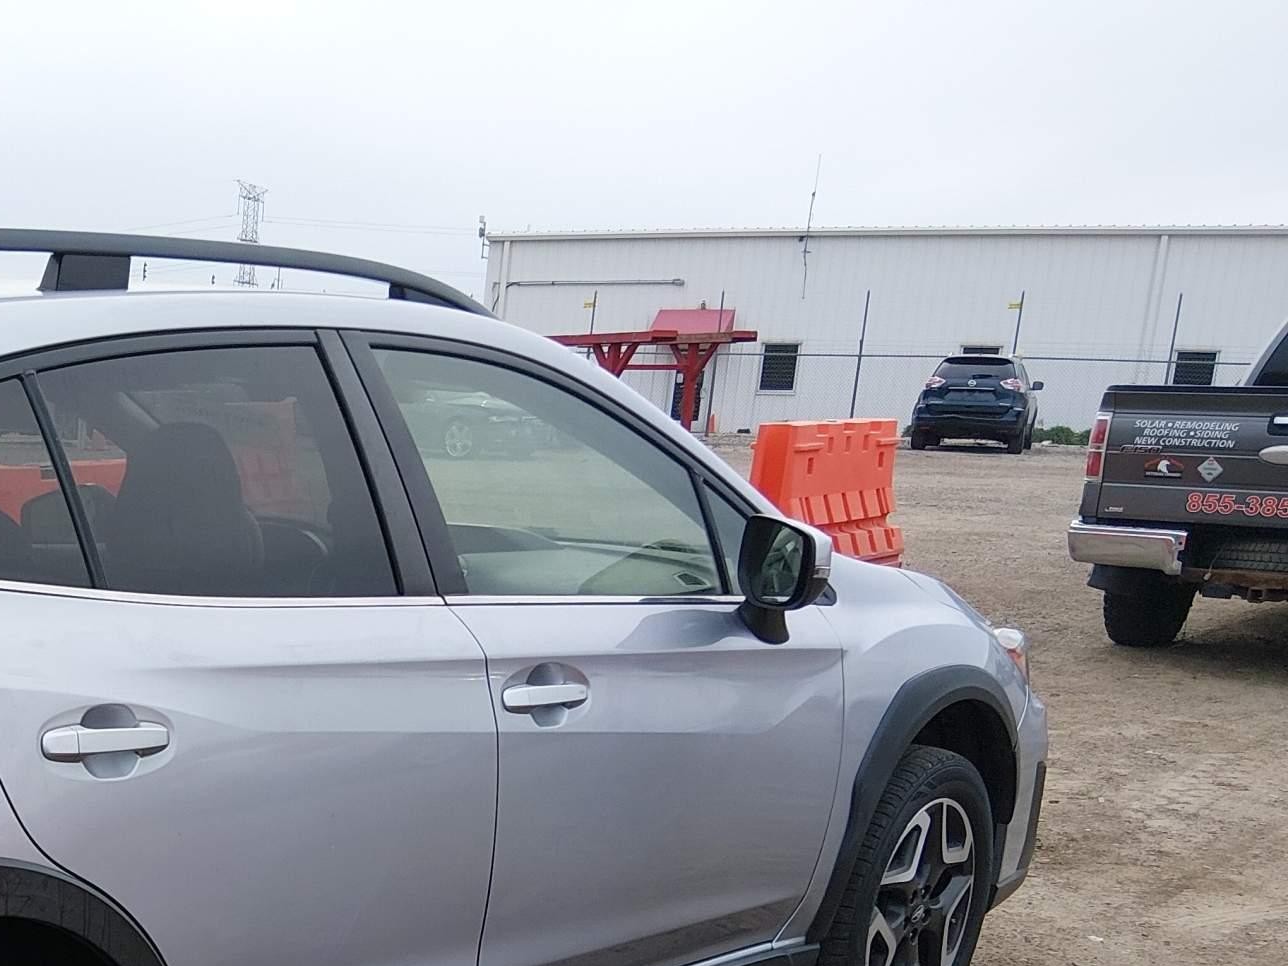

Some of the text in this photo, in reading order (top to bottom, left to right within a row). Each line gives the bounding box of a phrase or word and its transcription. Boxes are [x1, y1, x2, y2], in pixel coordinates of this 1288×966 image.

[1134, 419, 1241, 432] SOLAR REMODELING
[1143, 428, 1231, 439] ROOFING SIDING
[1133, 436, 1236, 449] NEW CONSTRUCTION
